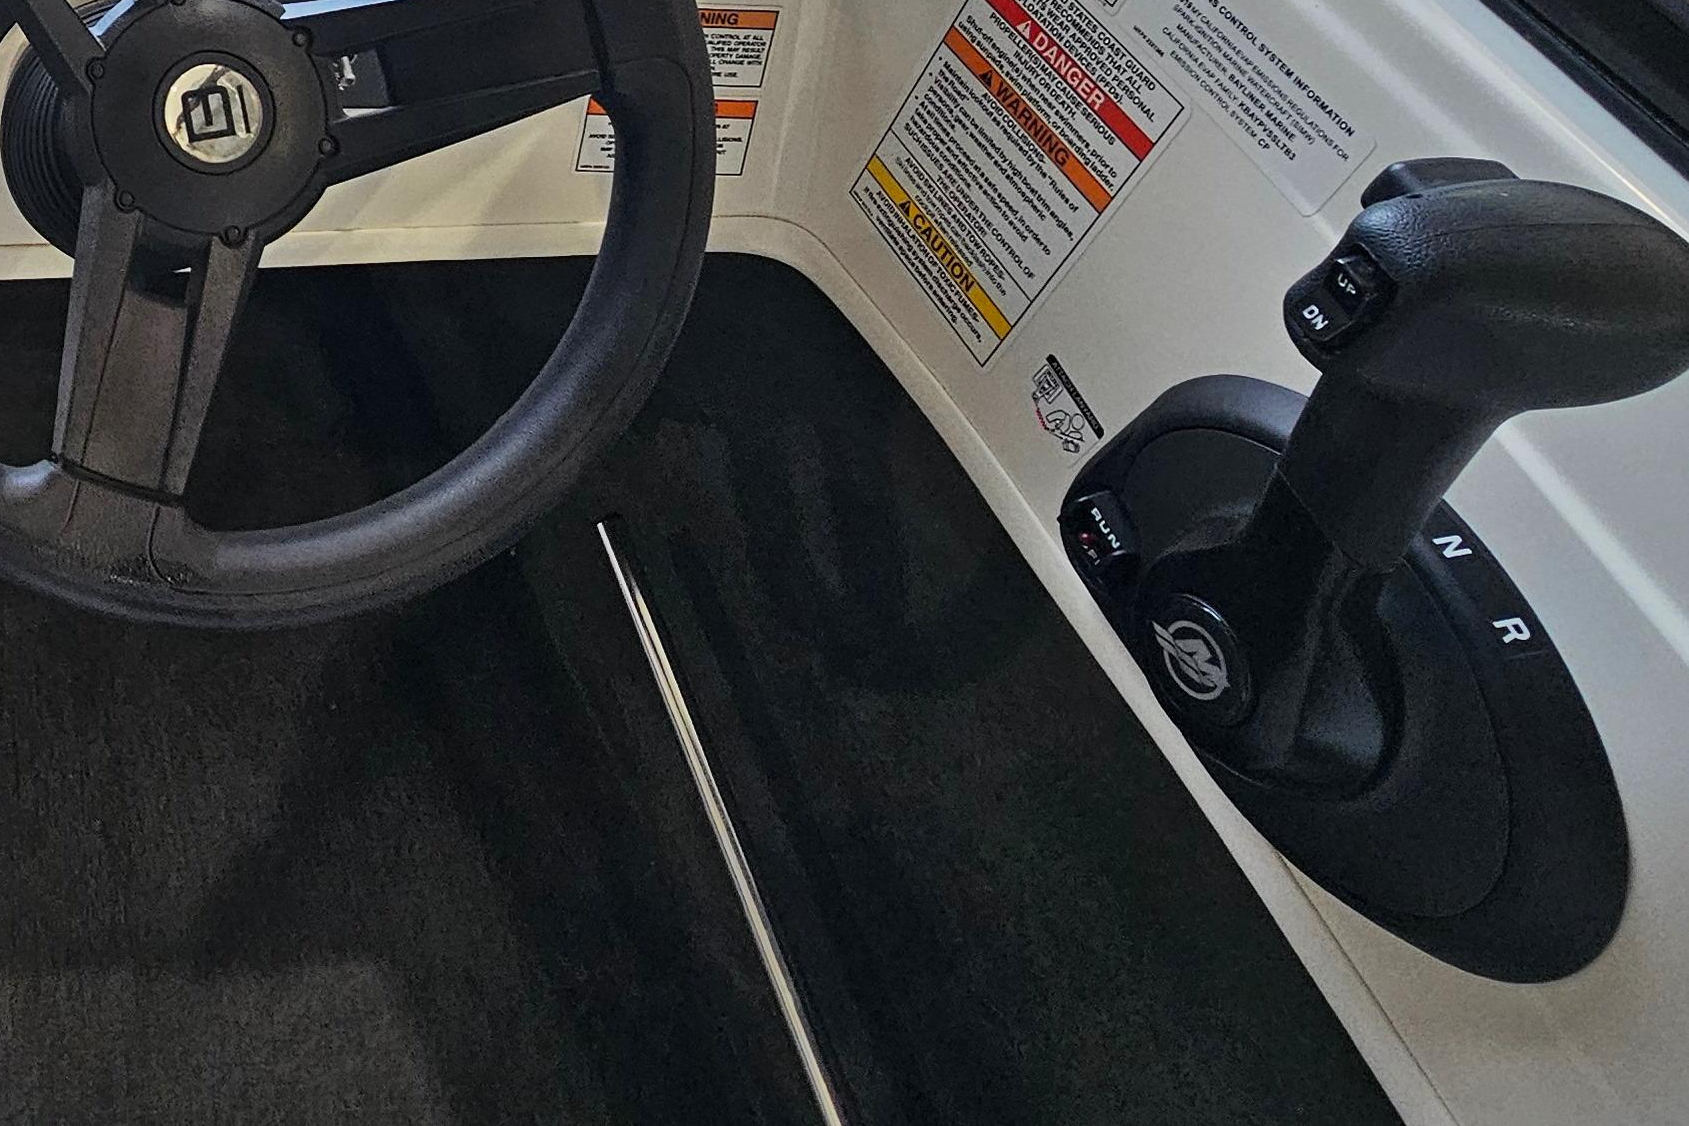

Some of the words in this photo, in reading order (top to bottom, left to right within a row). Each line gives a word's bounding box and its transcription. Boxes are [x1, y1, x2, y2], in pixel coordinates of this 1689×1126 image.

[700, 12, 739, 25] NING
[1066, 0, 1099, 35] STATES
[1096, 30, 1127, 62] COAST
[1124, 57, 1156, 91] GUARD
[966, 14, 993, 45] Shut-off
[989, 40, 1023, 78] engine(s)
[1020, 72, 1041, 96] when
[1037, 93, 1055, 112] near
[1052, 108, 1093, 153] swimmers,
[1088, 147, 1110, 172] prior
[1107, 166, 1118, 179] to
[988, 11, 1042, 69] PROPELLER(S)
[1039, 63, 1057, 84] MAY
[1054, 79, 1083, 111] CAUSE
[1079, 106, 1116, 146] SERIOUS
[1012, 49, 1040, 81] INJURY
[1037, 75, 1052, 93] OR
[1048, 87, 1078, 120] DEATH.
[1032, 31, 1106, 111] DANGER
[1044, 7, 1070, 35] WEAR
[1068, 30, 1113, 78] APPROVED
[1110, 73, 1156, 122] PERSONAL
[1062, 39, 1097, 77] DEVICES
[1094, 72, 1125, 106] (PFDs).
[1103, 52, 1127, 78] THAT
[1124, 73, 1144, 94] ALL
[1216, 4, 1259, 46] CONTROL
[1256, 41, 1294, 79] SYSTEM
[1291, 74, 1356, 137] INFORMATION
[957, 19, 978, 43] using
[1004, 69, 1023, 92] swim
[1020, 87, 1053, 125] platform,
[1050, 120, 1060, 132] or
[1057, 127, 1092, 167] boarding
[1089, 161, 1115, 191] ladder.
[981, 90, 1004, 118] AVOID
[994, 81, 1070, 167] WARNING
[903, 122, 922, 146] SUCH
[919, 141, 944, 172] ISSUES
[941, 167, 957, 188] ARE
[954, 183, 980, 215] UNDER
[977, 211, 993, 231] THE
[989, 226, 1025, 269] CONTROL
[1021, 265, 1034, 280] OF
[936, 175, 950, 193] THE
[876, 189, 895, 215] AVOID
[926, 254, 938, 270] OF
[935, 265, 956, 293] TOXIC
[911, 211, 974, 293] CAUTION
[1302, 304, 1329, 331] DN
[1337, 273, 1356, 295] UP
[1091, 507, 1120, 549] RUN
[1432, 534, 1473, 559] N
[1493, 616, 1531, 644] R
